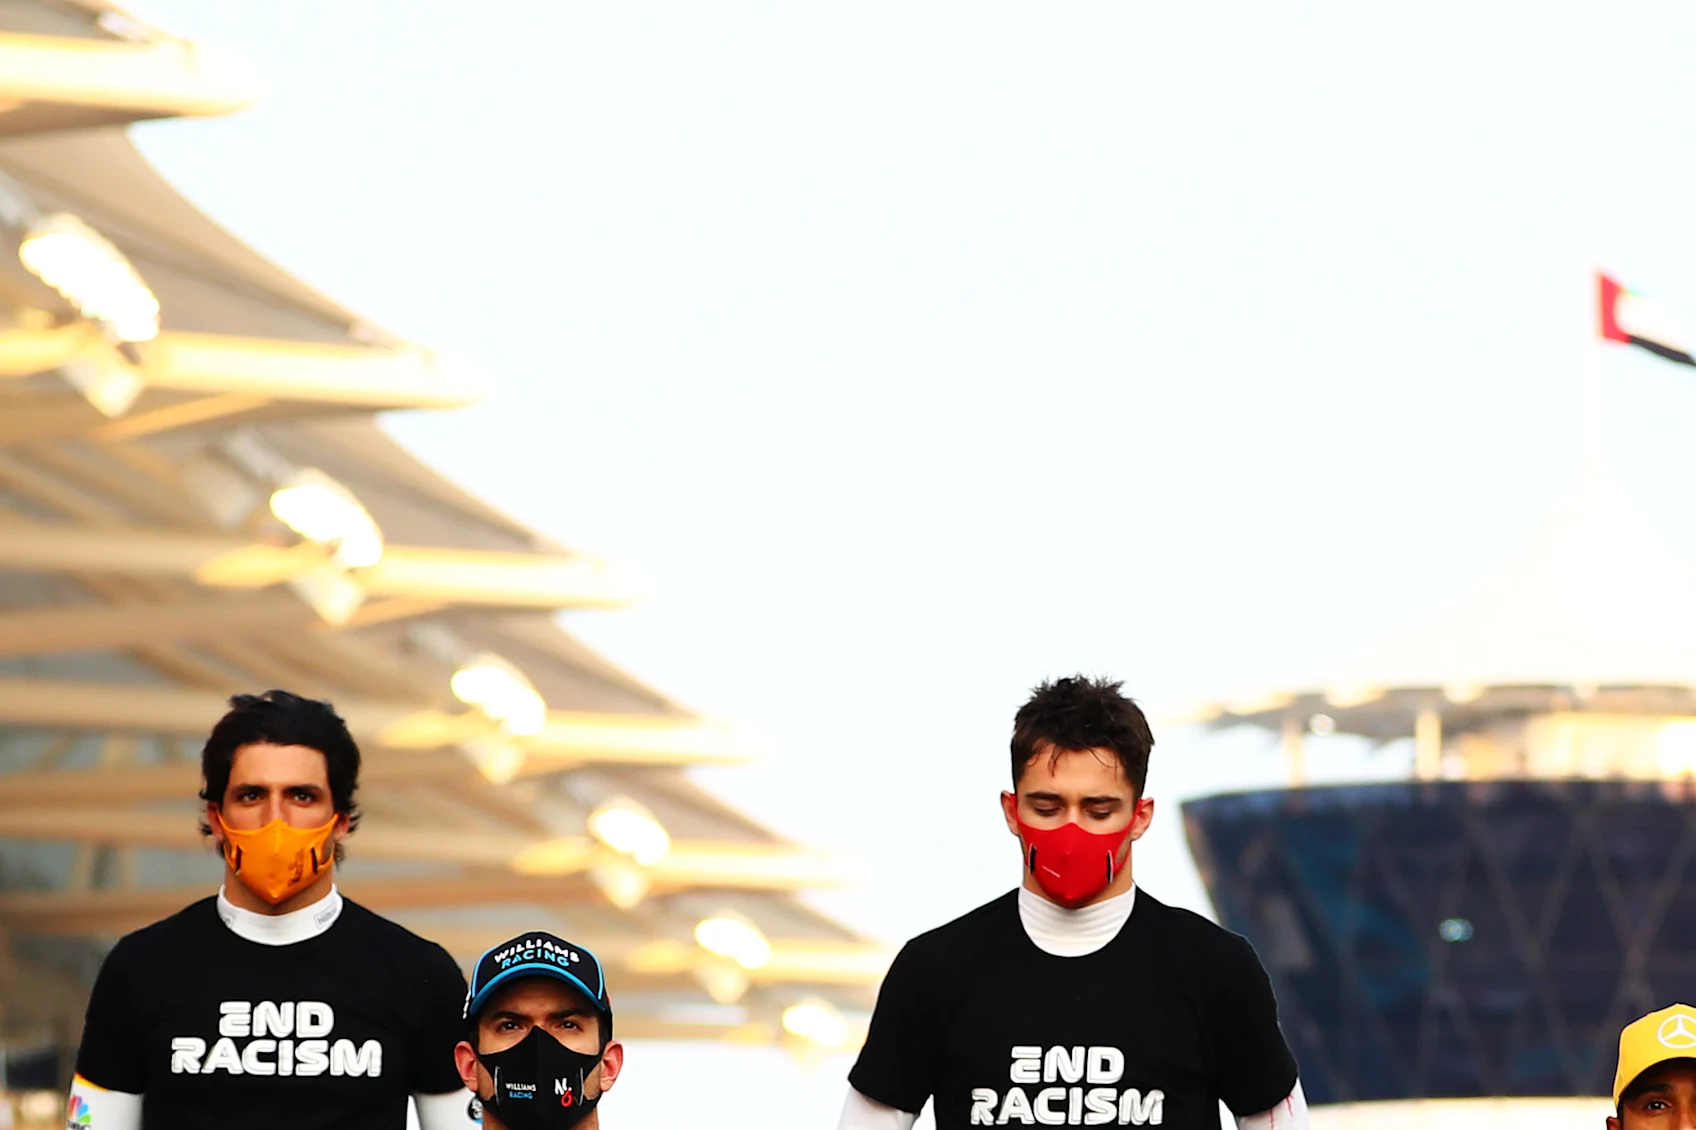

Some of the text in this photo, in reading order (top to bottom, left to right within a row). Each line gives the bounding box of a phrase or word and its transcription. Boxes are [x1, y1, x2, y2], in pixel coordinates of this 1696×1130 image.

[494, 939, 580, 963] WILLIAMS
[502, 948, 570, 969] RACING
[219, 1001, 334, 1038] END
[171, 1037, 382, 1078] RACISM
[1010, 1045, 1125, 1084] END
[505, 1083, 537, 1092] WILLIAMS
[509, 1091, 533, 1100] RACING
[970, 1086, 1165, 1126] RACISM
